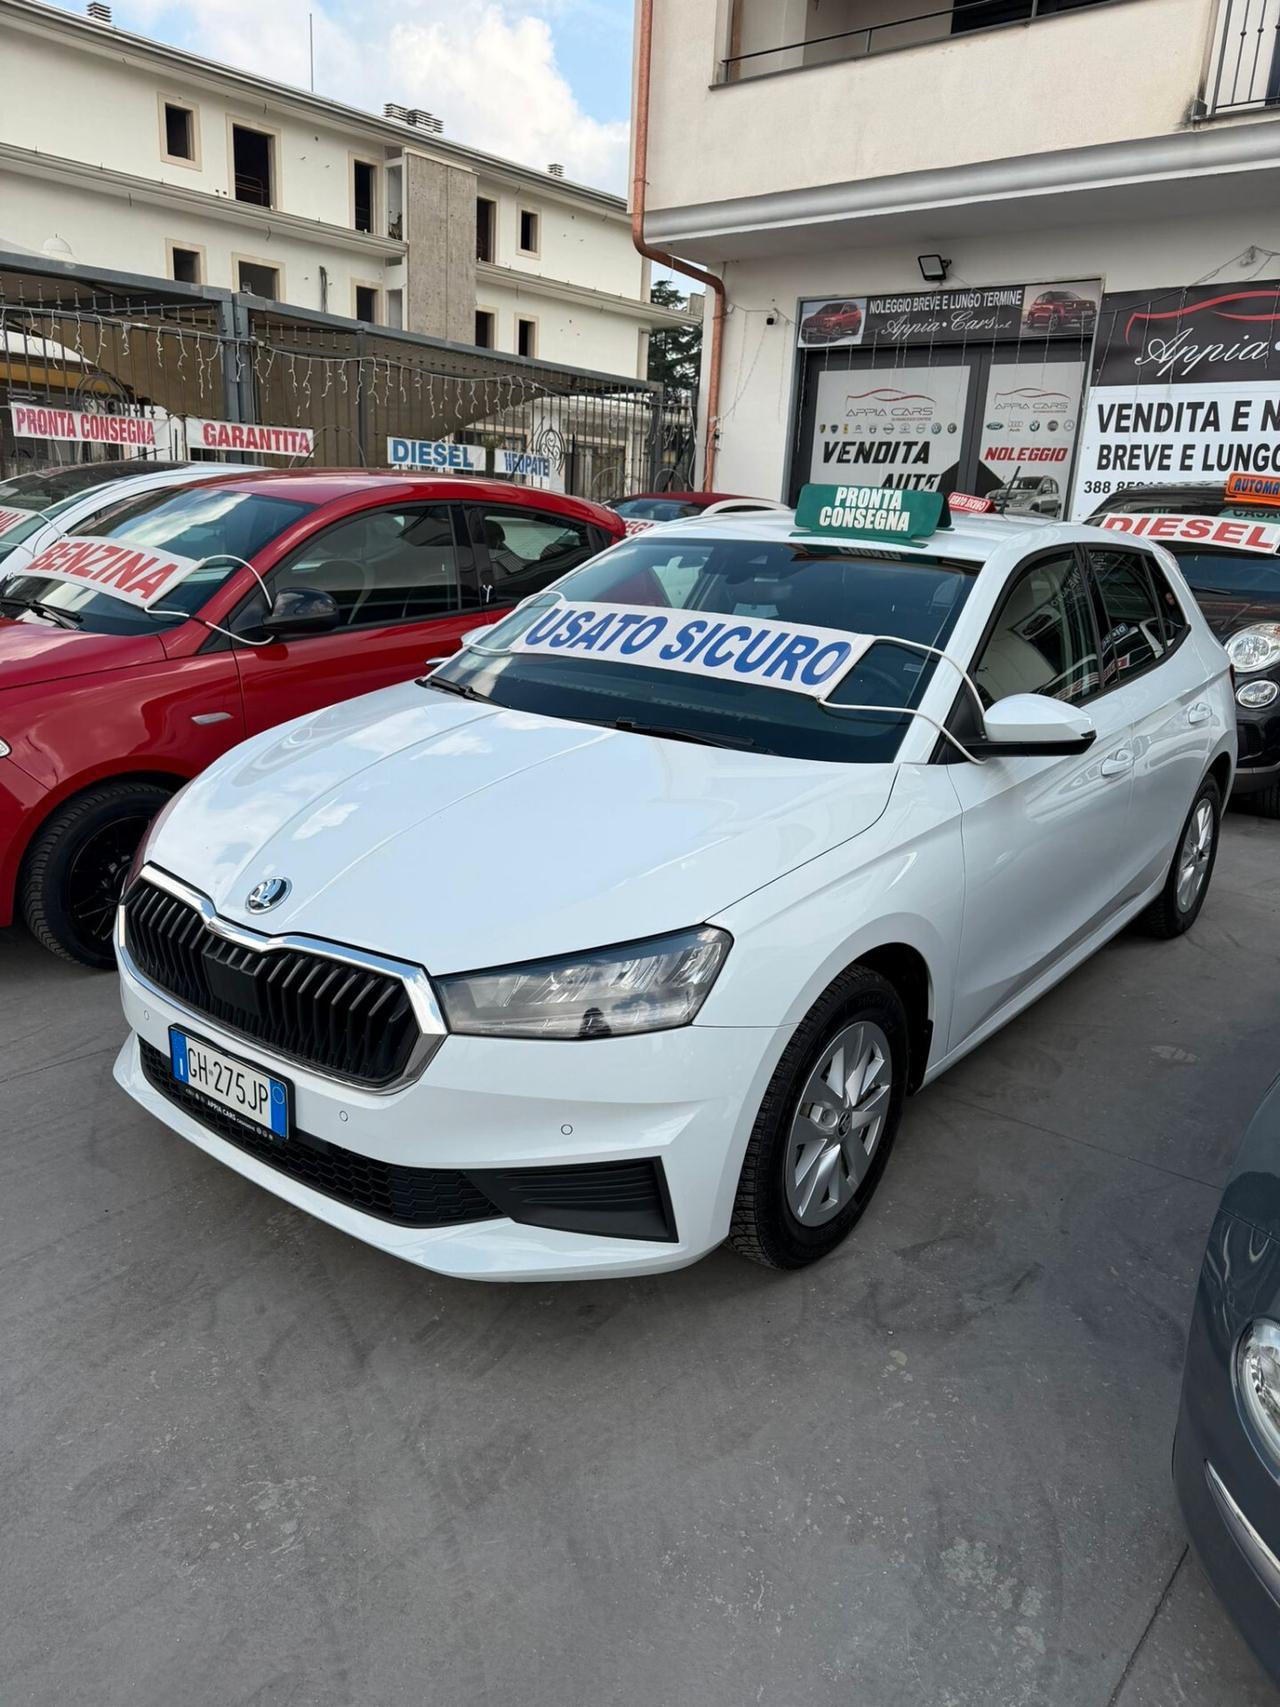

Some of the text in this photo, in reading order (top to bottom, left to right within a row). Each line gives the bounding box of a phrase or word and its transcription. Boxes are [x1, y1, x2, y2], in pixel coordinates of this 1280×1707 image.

[869, 289, 1022, 314] NOLEGGIO BREVE E LUNGO TERMINE
[881, 315, 940, 340] Appia
[1134, 328, 1269, 377] Appia
[846, 407, 934, 417] APPIA CARS
[994, 401, 1069, 410] APPIA CARS
[1097, 401, 1221, 433] VENDITA
[1231, 400, 1252, 431] E
[16, 408, 156, 445] PRONTA CONSEGNA
[202, 422, 312, 453] GARANTITA
[392, 439, 475, 468] DIESEL
[823, 441, 930, 464] VENDITA
[984, 447, 1069, 462] NOLEGGIO
[1096, 444, 1173, 471] BREVE
[1179, 444, 1196, 471] E
[834, 486, 904, 509] PRONTA
[1083, 481, 1111, 493] 388
[819, 507, 910, 532] CONSEGNA
[1103, 516, 1275, 549] DIESEL
[26, 542, 179, 600] BENZINA
[525, 608, 852, 686] USATO SICURO
